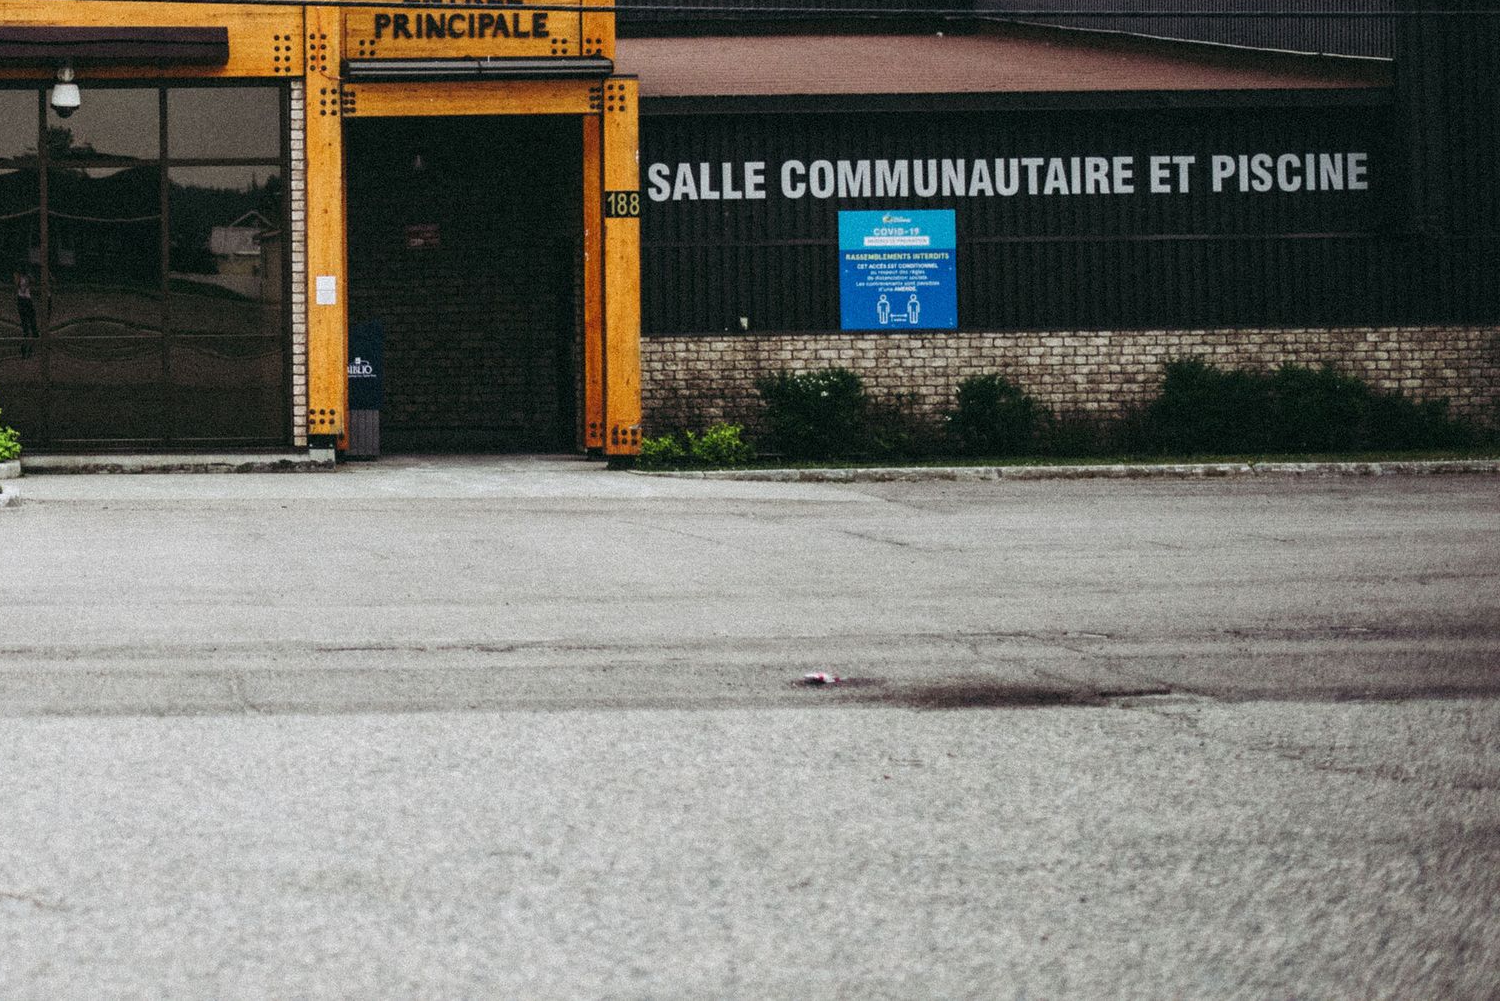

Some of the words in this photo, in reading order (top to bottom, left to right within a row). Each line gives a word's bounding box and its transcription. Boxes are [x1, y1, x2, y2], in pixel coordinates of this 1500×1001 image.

[374, 12, 550, 39] PRINCIPALE
[647, 161, 766, 202] SALLE
[780, 156, 1135, 199] COMMUNAUTAIRE
[1150, 155, 1196, 193] ET
[1212, 152, 1368, 191] PISCINE
[607, 193, 640, 216] 188
[873, 227, 920, 236] COVID-19
[845, 253, 912, 261] RASSEMBLEMENTS
[912, 252, 950, 260] INTERDITS
